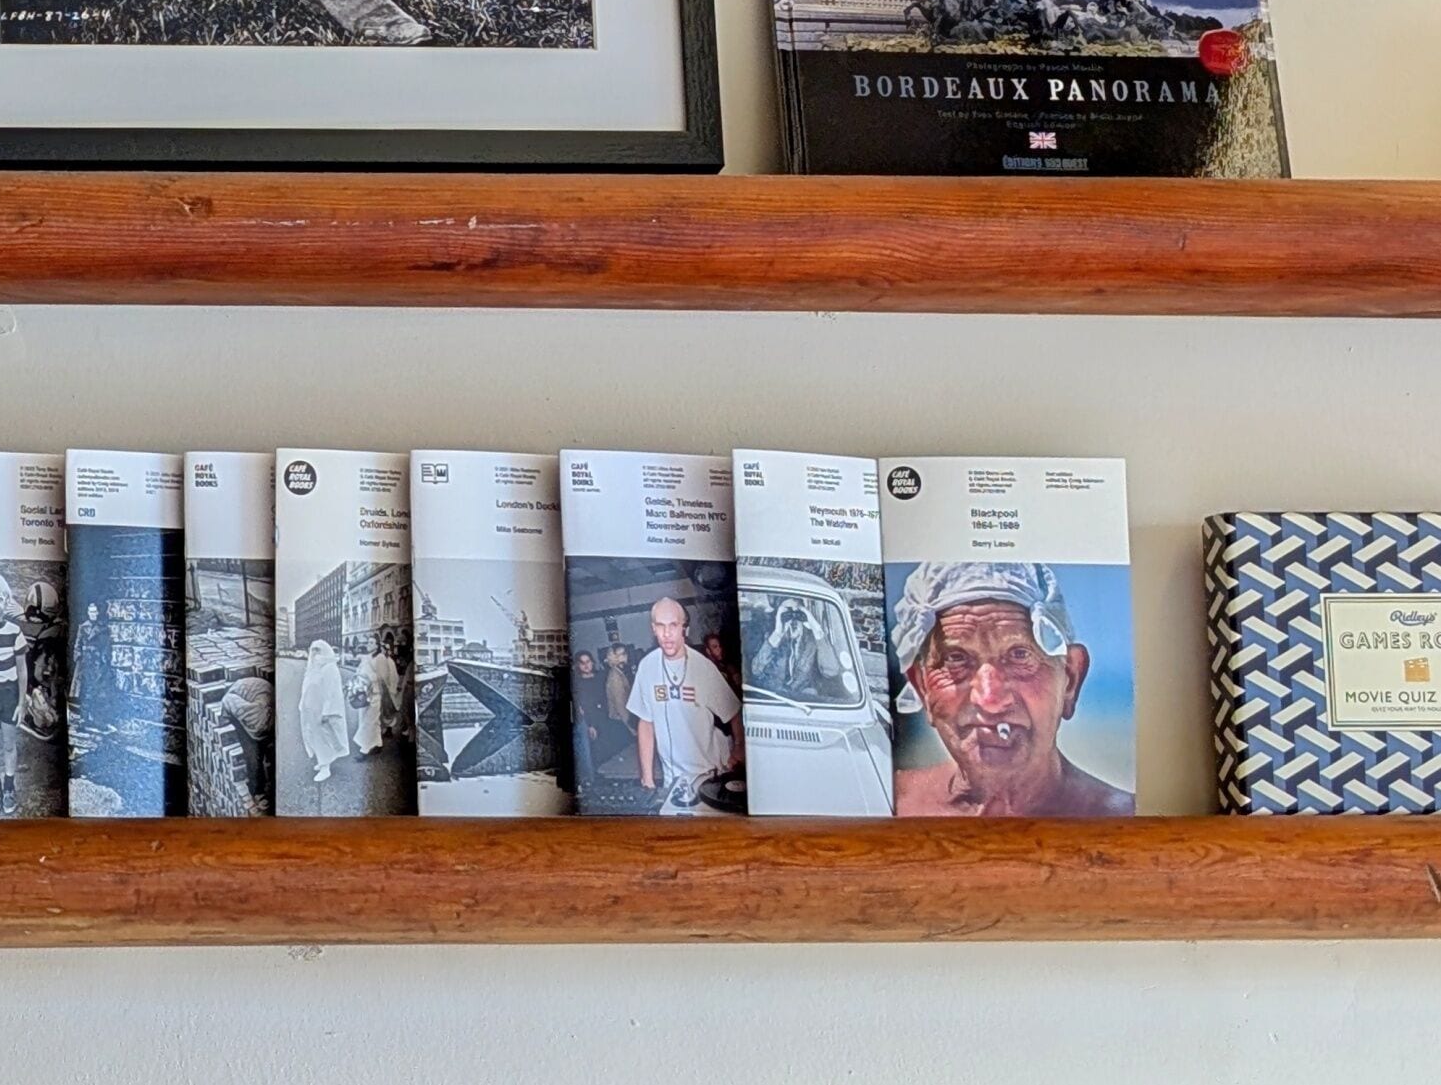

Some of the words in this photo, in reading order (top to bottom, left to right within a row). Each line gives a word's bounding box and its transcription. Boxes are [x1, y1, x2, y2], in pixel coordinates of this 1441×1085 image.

[854, 74, 1031, 101] BORDEAUX
[1047, 78, 1223, 104] PANORAMA
[496, 499, 534, 510] London's
[970, 508, 1018, 519] Blackpool
[21, 518, 54, 528] Toronto
[1339, 631, 1412, 650] GAMES
[1345, 691, 1393, 704] MOVIE
[1398, 691, 1438, 705] QUIZ
